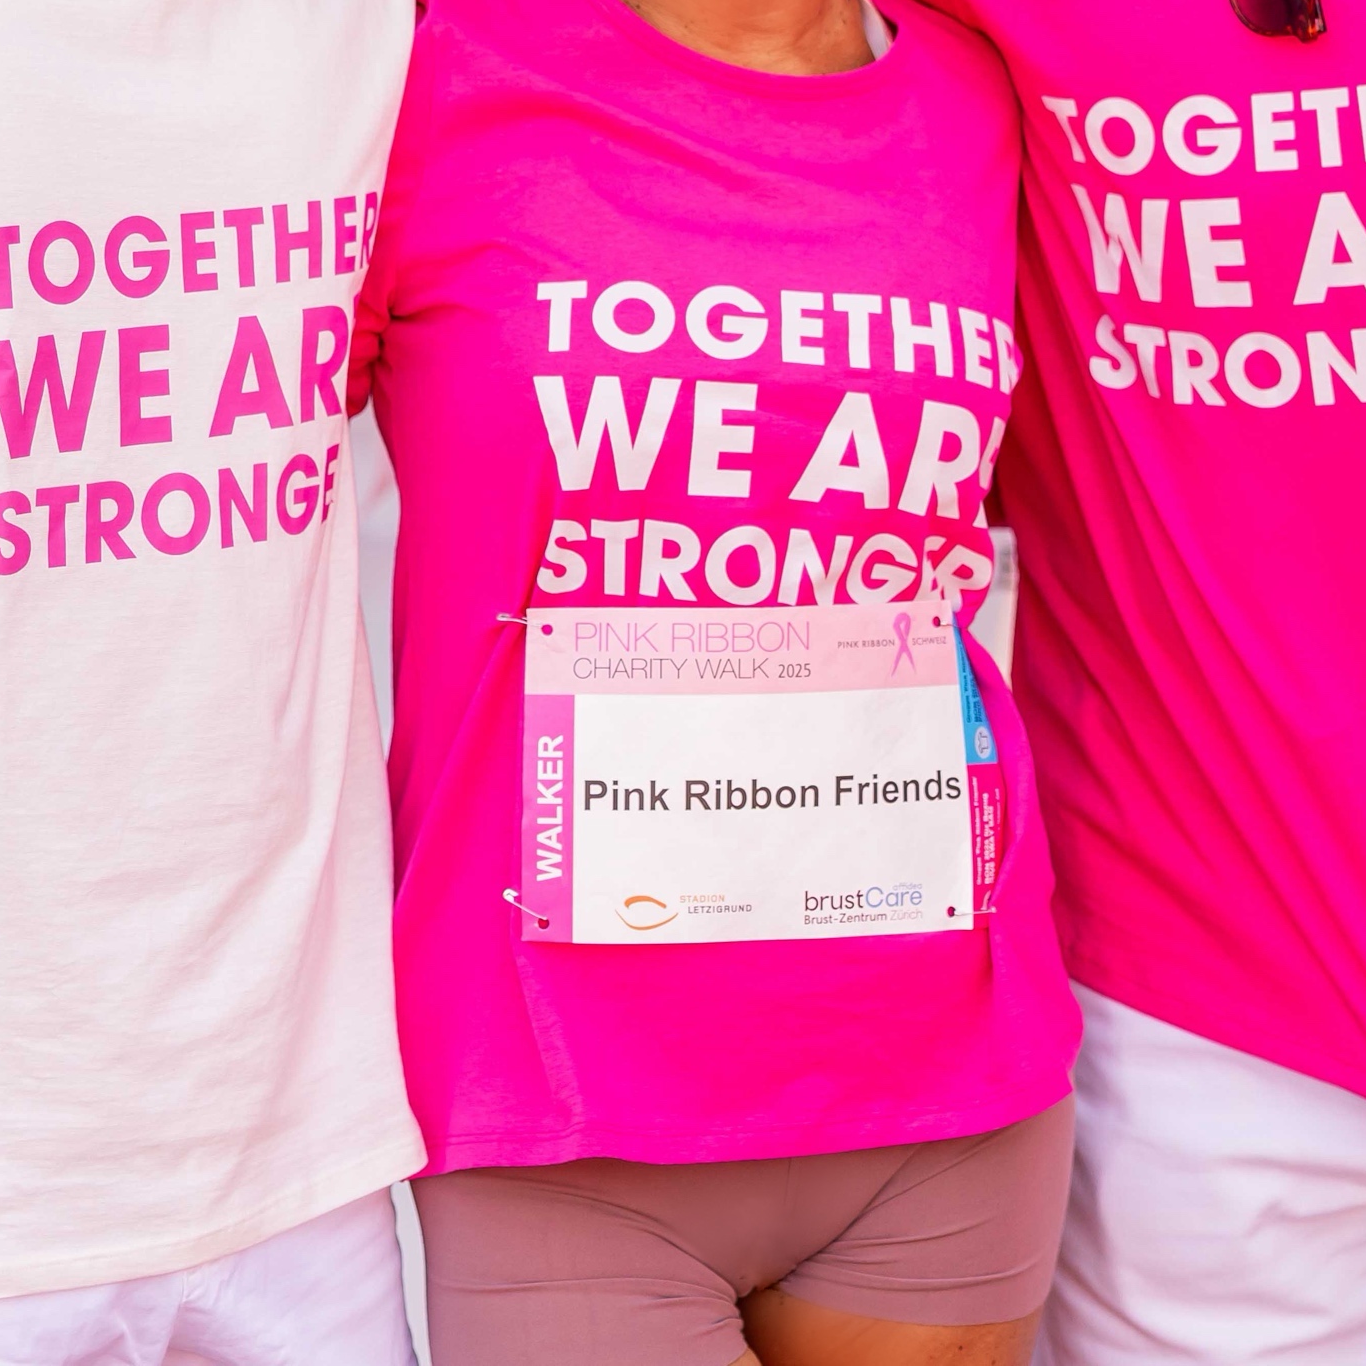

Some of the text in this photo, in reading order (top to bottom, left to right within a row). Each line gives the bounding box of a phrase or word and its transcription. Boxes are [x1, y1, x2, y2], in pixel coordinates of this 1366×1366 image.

[1069, 183, 1253, 308] WE
[536, 280, 1020, 395] TOGETHER
[208, 293, 360, 438] AR
[532, 374, 759, 499] WE
[574, 621, 810, 653] PINK RIBBON
[837, 636, 947, 649] PINK RIBBON SCHWEIZ
[572, 657, 812, 680] CHARITY WALK 2025
[584, 769, 962, 812] Pink Ribbon Friends
[536, 734, 564, 882] WALKER
[679, 894, 726, 904] STADION
[687, 904, 753, 915] LETZIGRUND
[804, 886, 923, 912] brustCare
[803, 912, 888, 926] Brust-Zentrum
